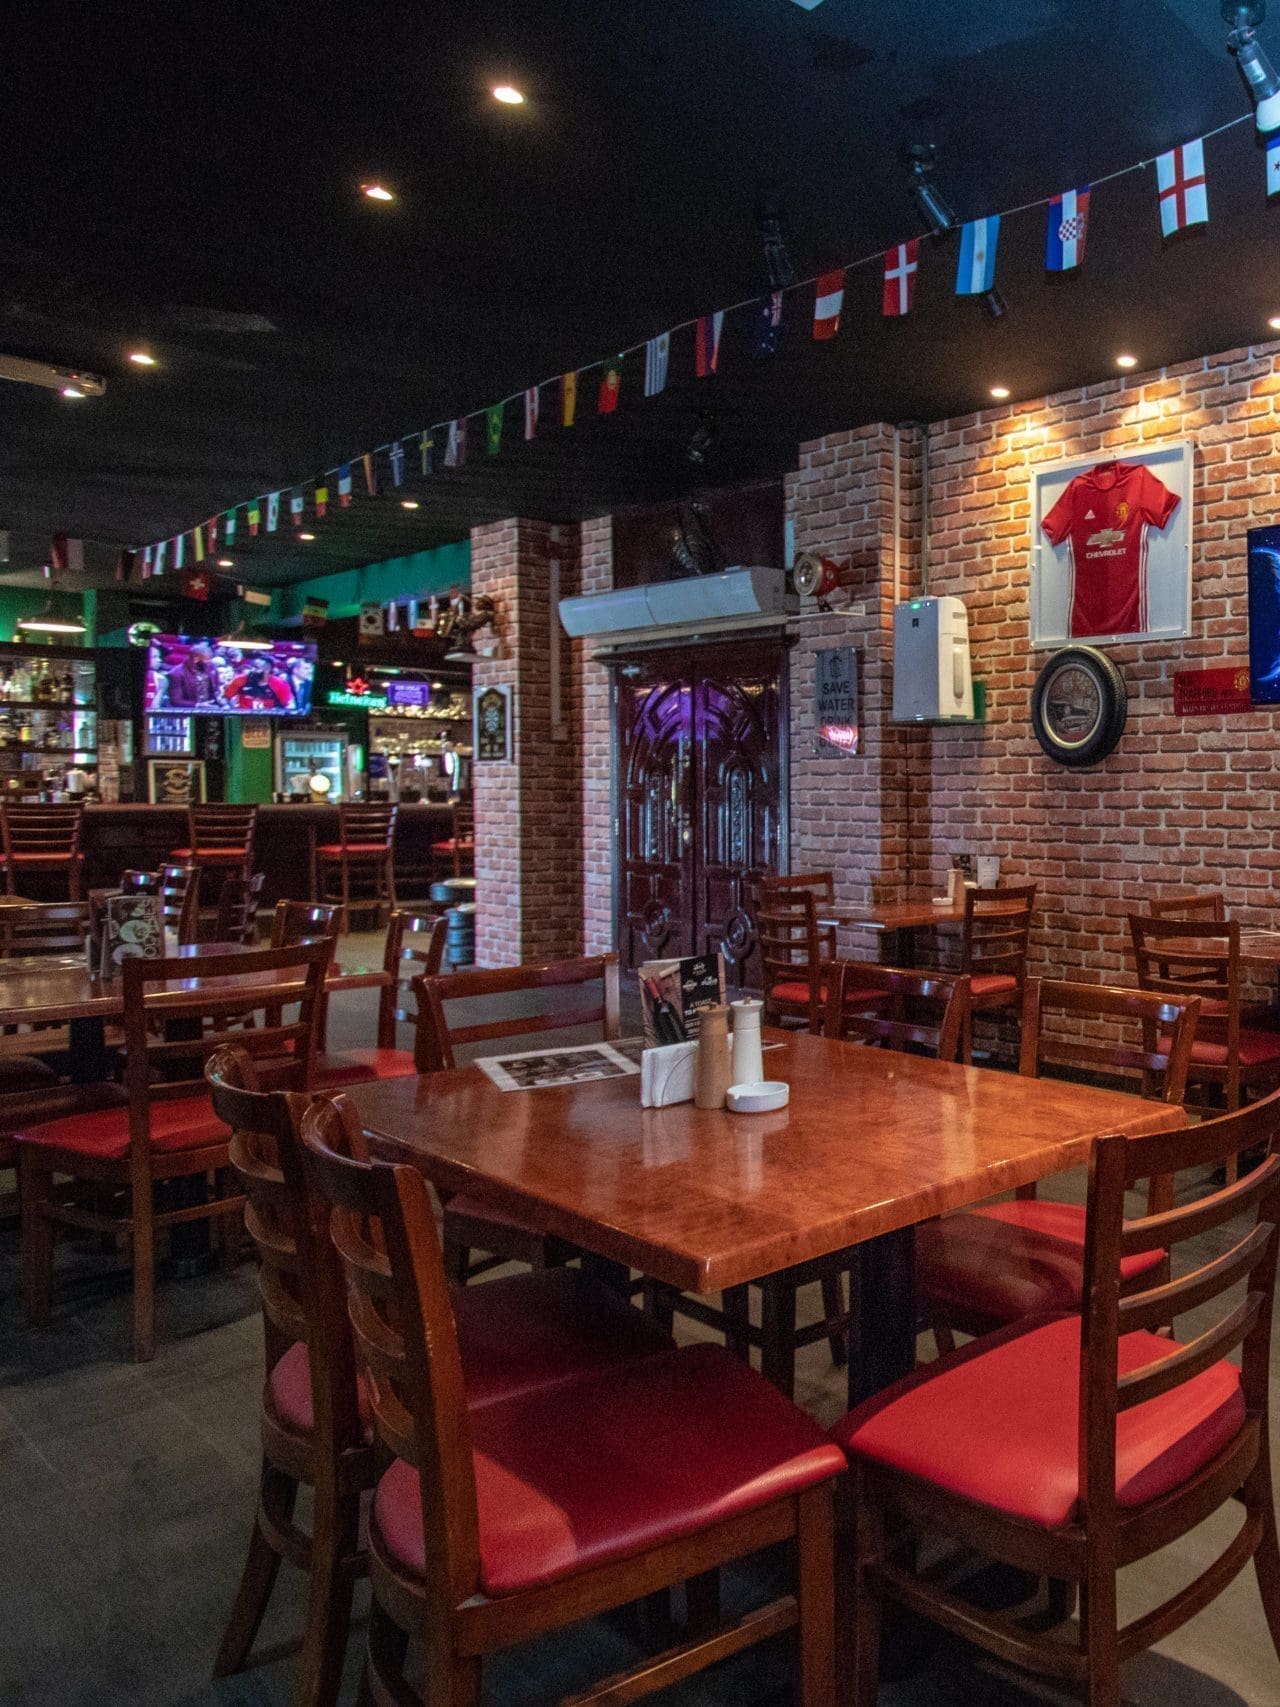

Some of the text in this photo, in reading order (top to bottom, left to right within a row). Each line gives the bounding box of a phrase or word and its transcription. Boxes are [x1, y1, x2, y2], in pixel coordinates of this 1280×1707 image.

[1086, 548, 1127, 559] CHEVROLET
[822, 681, 850, 695] SAVE
[328, 691, 387, 708] Heineken
[819, 698, 855, 711] WATER
